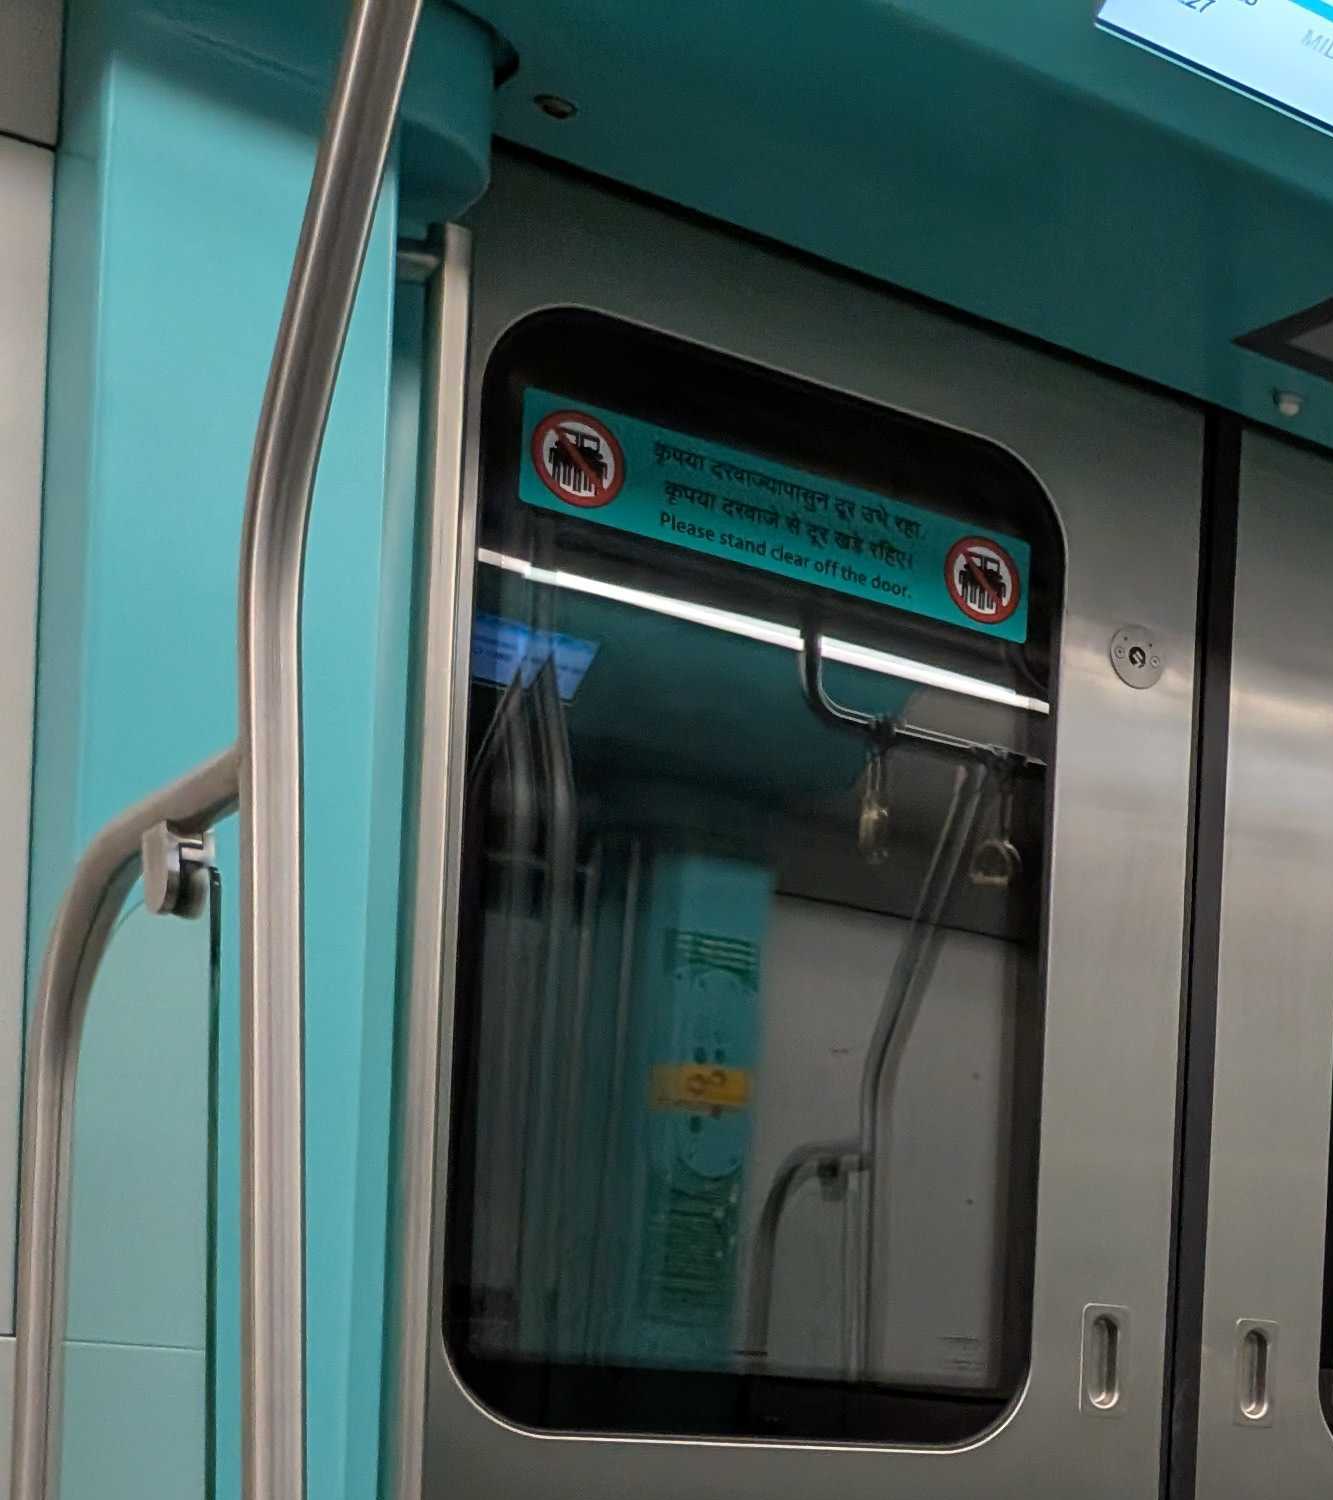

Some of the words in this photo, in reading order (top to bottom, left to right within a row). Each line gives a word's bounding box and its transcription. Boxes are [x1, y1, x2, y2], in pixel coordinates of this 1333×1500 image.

[660, 511, 715, 542] Please
[719, 532, 767, 556] stand
[770, 543, 811, 569] clear
[814, 558, 839, 577] off
[841, 564, 868, 586] the
[871, 575, 912, 599] door.
